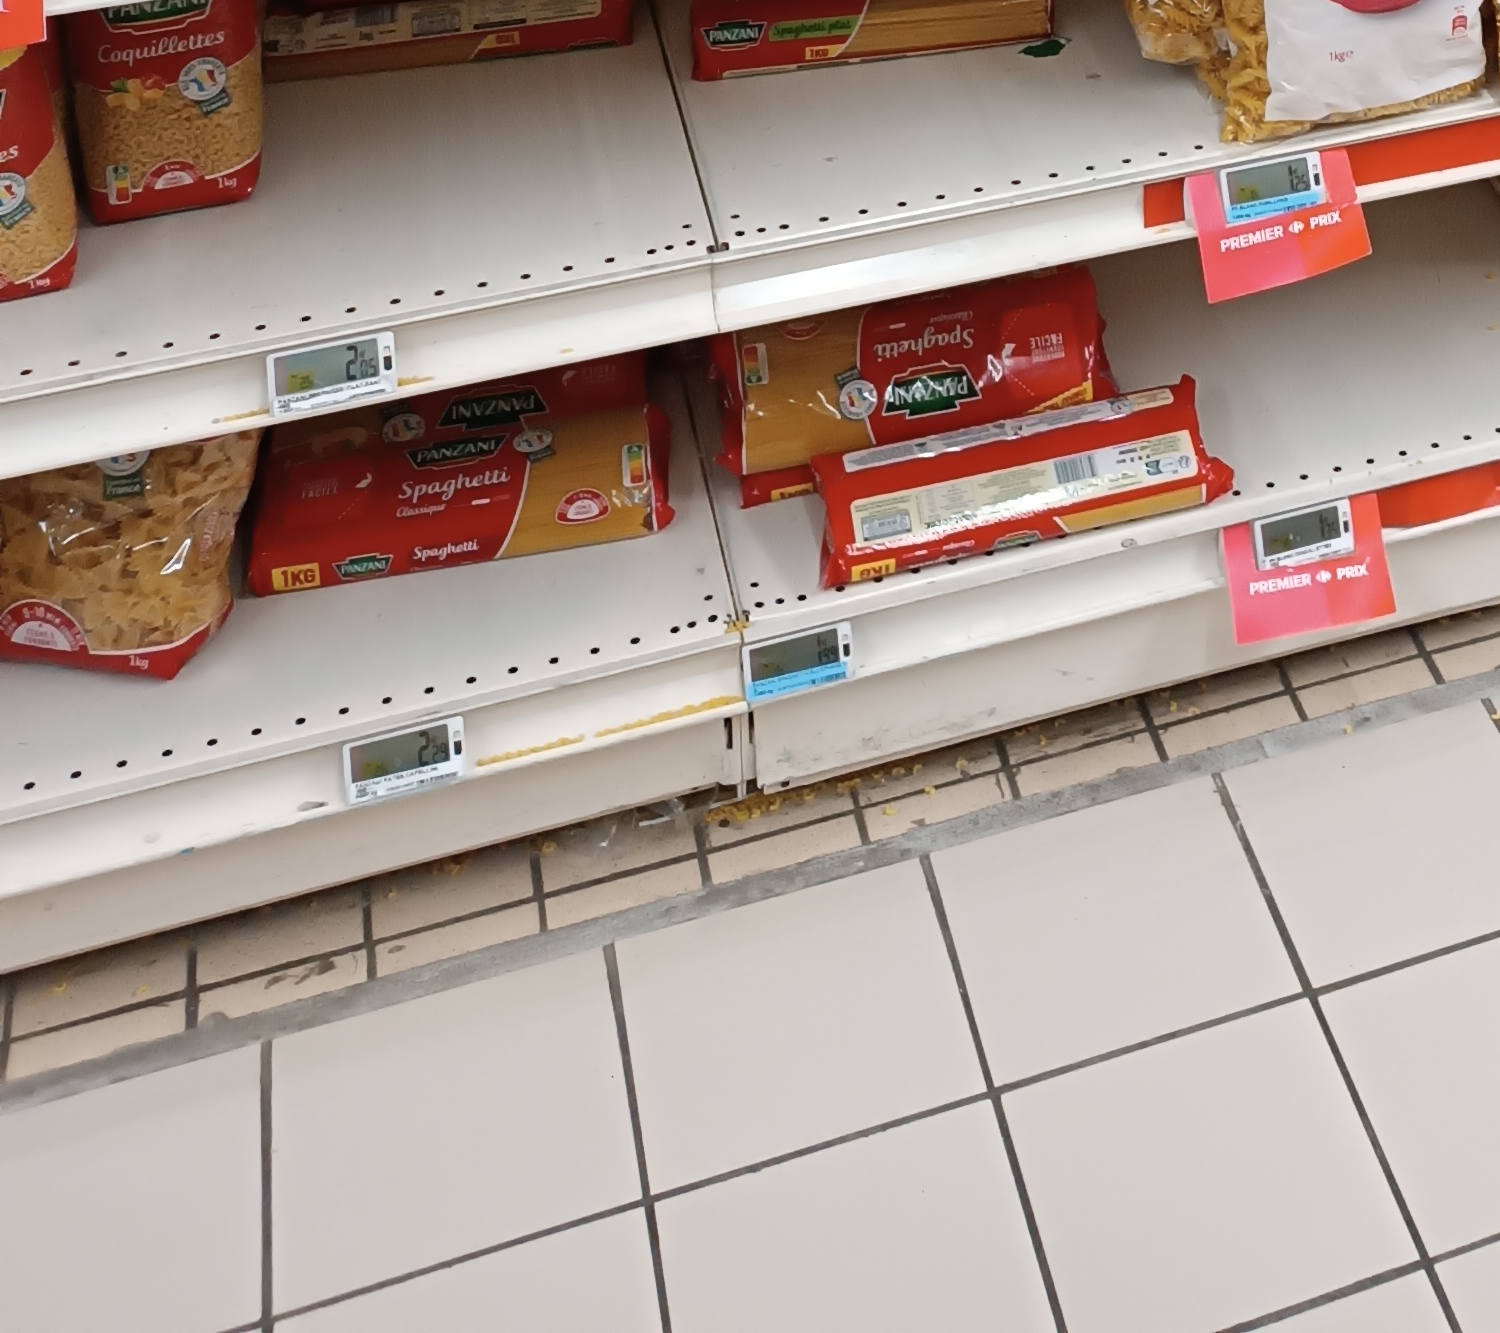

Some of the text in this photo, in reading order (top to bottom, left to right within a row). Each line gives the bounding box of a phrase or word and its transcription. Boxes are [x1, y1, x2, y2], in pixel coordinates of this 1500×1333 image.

[98, 31, 226, 65] Coquillettes
[708, 26, 760, 44] PANZANI
[1220, 211, 1342, 252] PREMIER PRIX
[875, 327, 975, 362] Spaghetti
[451, 393, 535, 419] PANZANI
[415, 437, 499, 463] PANZANI
[397, 466, 511, 503] Spaghetti
[412, 538, 480, 563] Spaghetti
[280, 566, 318, 589] 1KG
[341, 560, 388, 576] PANZANI
[1249, 564, 1368, 595] PREMIER PRIX
[128, 654, 150, 670] 1kg
